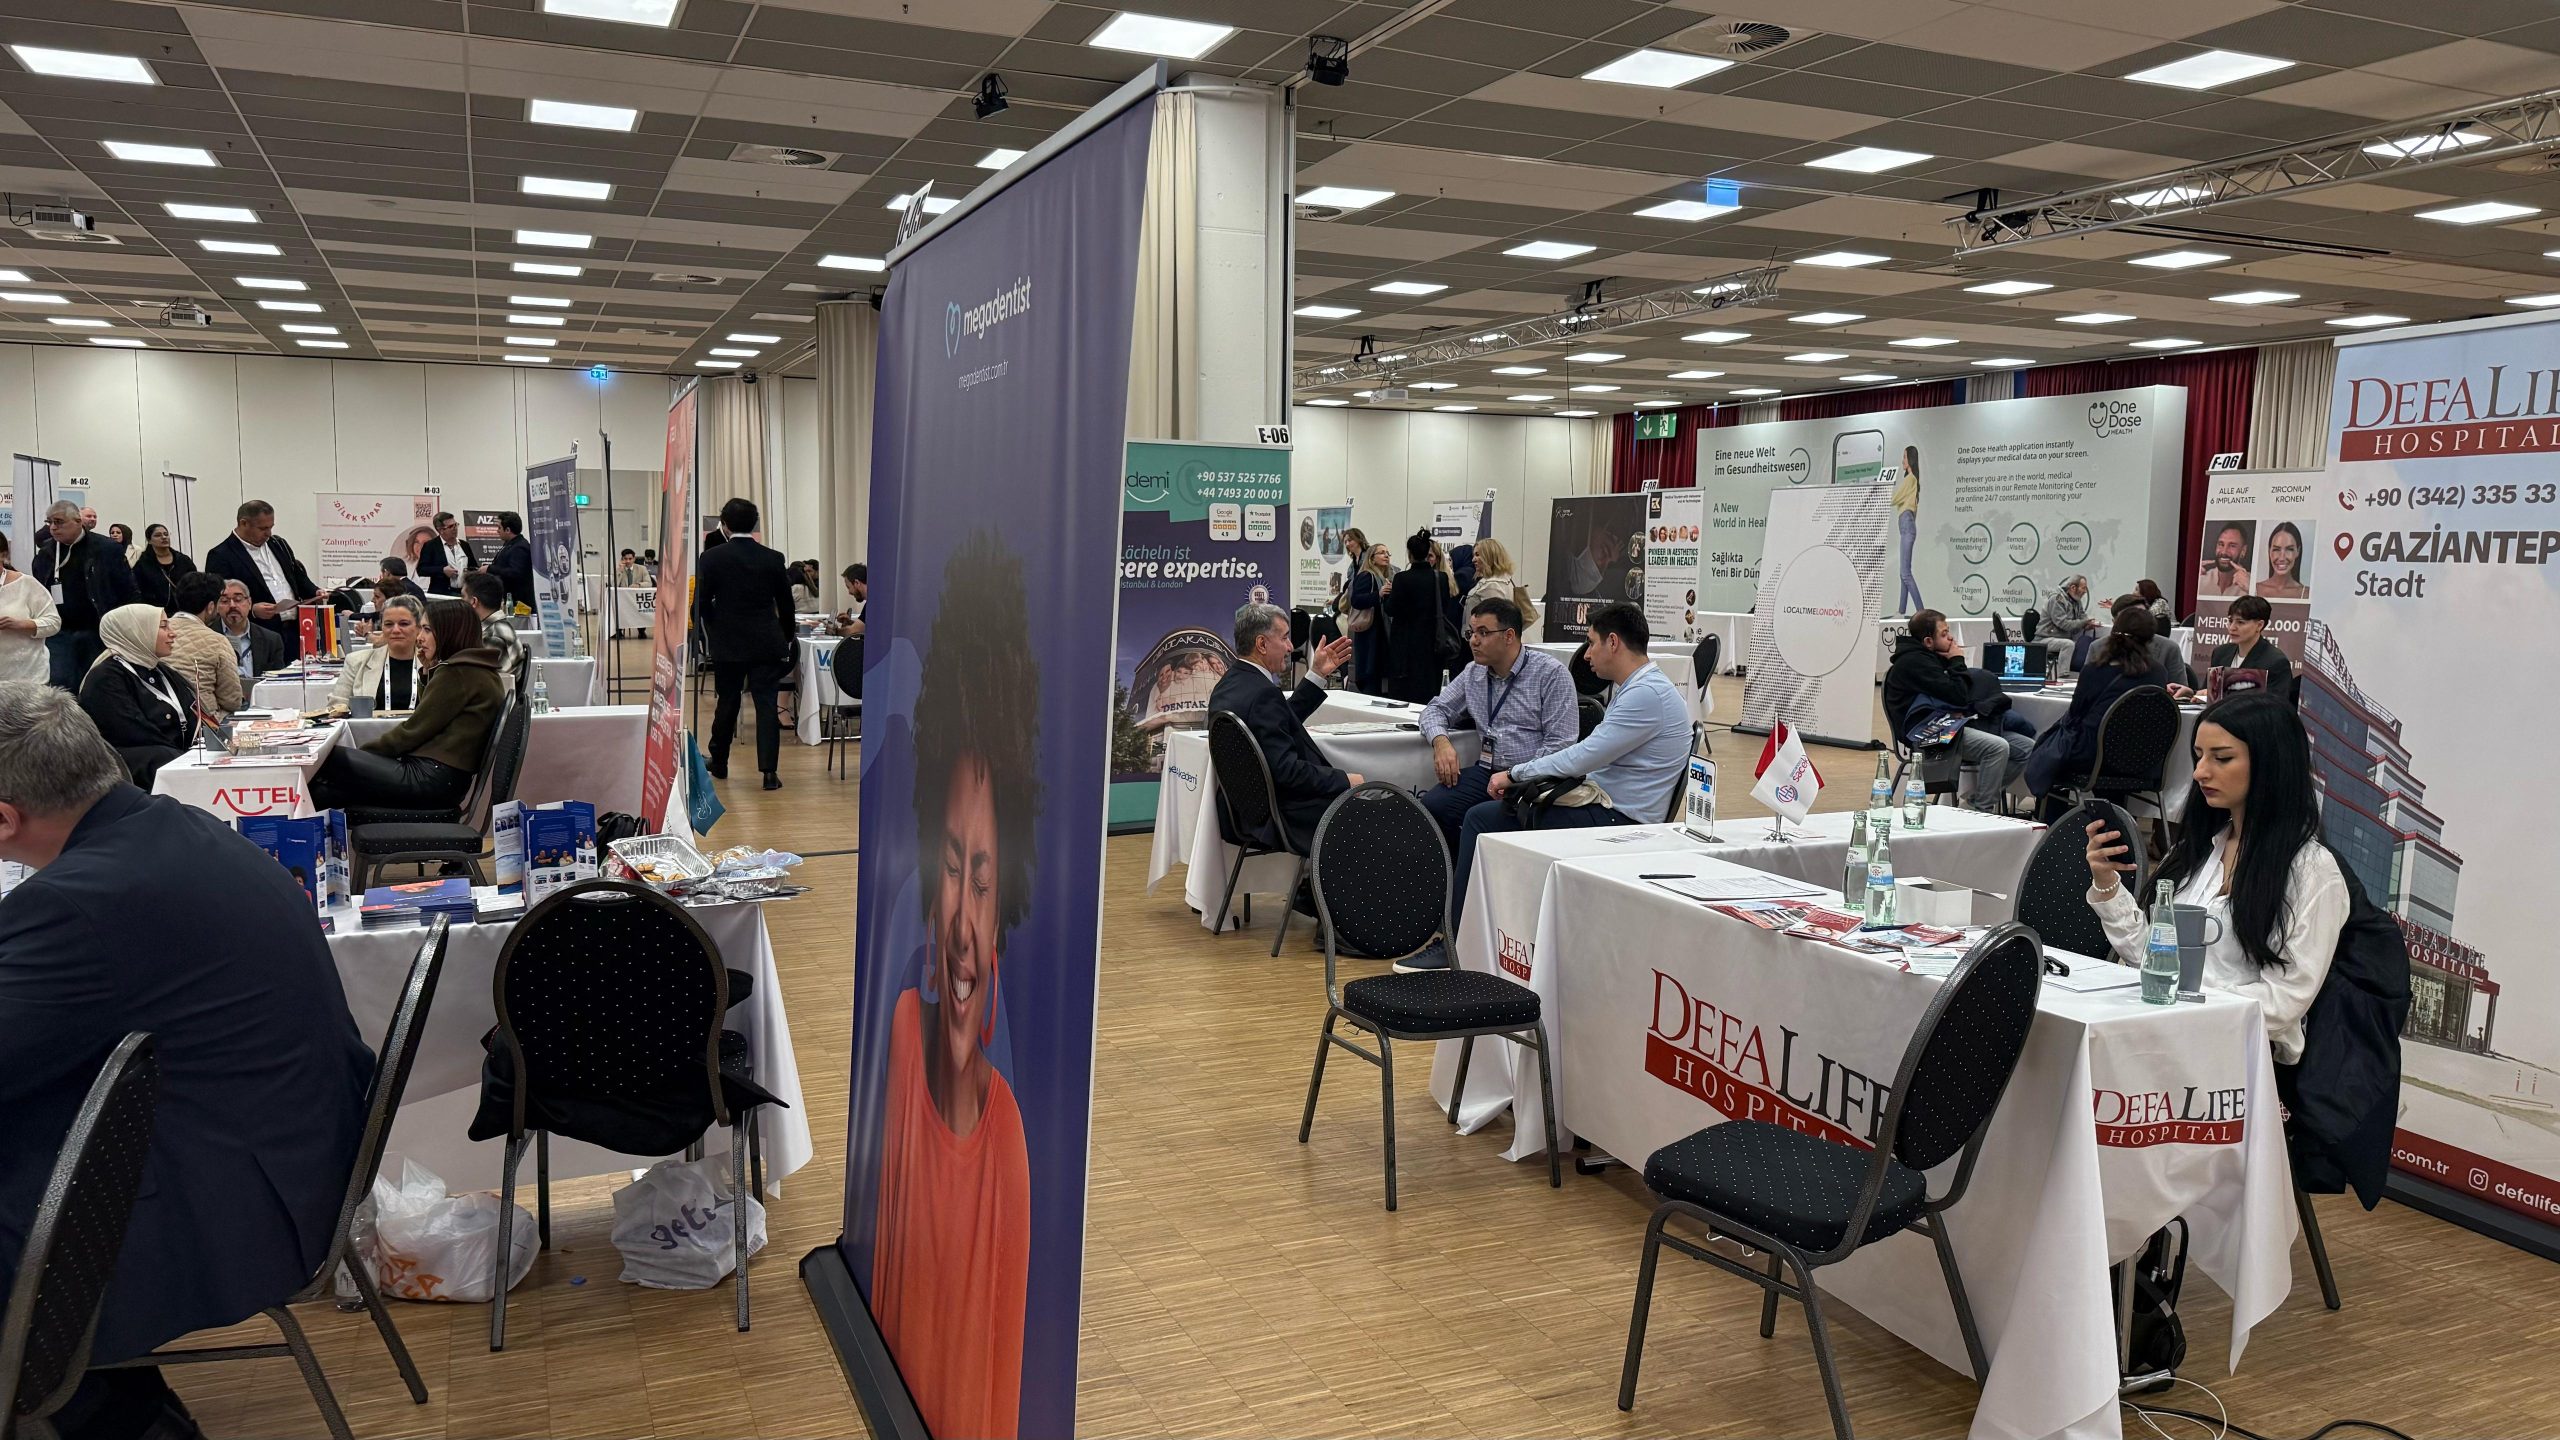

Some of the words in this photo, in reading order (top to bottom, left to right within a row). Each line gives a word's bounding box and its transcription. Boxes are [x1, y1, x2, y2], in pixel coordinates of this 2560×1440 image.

[963, 276, 1031, 339] megadentist
[958, 360, 1009, 391] megadentist.com.tr
[2109, 401, 2137, 414] One
[2109, 415, 2142, 428] Dose
[1259, 427, 1289, 444] E-06
[1987, 444, 2008, 452] Health
[2009, 442, 2044, 452] application
[2045, 439, 2074, 450] instantly
[1715, 450, 1732, 460] Eine
[1733, 450, 1754, 459] neue
[1756, 447, 1776, 457] Welt
[1957, 454, 1981, 464] displays
[1997, 453, 2021, 462] medical
[2023, 452, 2037, 460] data
[2065, 450, 2089, 458] screen.
[1714, 466, 1724, 475] im
[1727, 462, 1805, 475] Gesundheitswesen
[2211, 455, 2240, 470] F-06
[1197, 472, 1215, 482] +90
[1217, 472, 1236, 483] 537
[1237, 473, 1256, 483] 525
[1258, 473, 1281, 484] 7766
[1880, 469, 1896, 481] F-07
[1956, 476, 1983, 484] Wherever
[2026, 473, 2046, 481] world,
[2047, 471, 2072, 480] medical
[71, 478, 89, 486] M-02
[1955, 485, 1994, 495] professionals
[2014, 483, 2038, 491] Remote
[2038, 482, 2073, 491] Monitoring
[2075, 481, 2096, 489] Center
[1197, 488, 1215, 498] +44
[1218, 489, 1241, 499] 7493
[1243, 489, 1256, 499] 20
[1257, 490, 1270, 499] 00
[1271, 490, 1283, 500] 01
[2271, 485, 2311, 494] ZIRCONIUM
[1984, 494, 1997, 502] 24/7
[1999, 493, 2030, 502] constantly
[2031, 492, 2066, 501] monitoring
[2067, 492, 2082, 500] your
[2365, 488, 2402, 507] +90
[2408, 484, 2466, 509] (342)
[2472, 485, 2517, 505] 335
[2525, 484, 2557, 504] 33
[1713, 504, 1719, 513] A
[1721, 503, 1739, 512] New
[1954, 505, 1973, 513] health.
[1713, 518, 1736, 528] World
[1738, 518, 1746, 527] in
[1748, 518, 1766, 527] Heal
[2055, 536, 2081, 544] Symptom
[2360, 523, 2560, 565] GAZİANTEP
[1174, 545, 1190, 560] ist
[1955, 544, 1983, 552] Monitoring
[1648, 556, 1669, 566] LEADER
[1669, 557, 1676, 565] IN
[1676, 556, 1697, 566] HEALTH
[1711, 552, 1743, 565] Sağlıkta
[1163, 557, 1262, 582] expertise.
[1712, 568, 1729, 577] Yeni
[1730, 568, 1741, 577] Bir
[1744, 567, 1760, 578] Dün
[1150, 580, 1157, 588] &
[1157, 580, 1183, 588] London
[2355, 570, 2425, 598] Stadt
[1965, 587, 1982, 595] Urgent
[2012, 596, 2032, 604] Opinion
[1783, 605, 1844, 617] LOCALTIMELONDON
[2198, 616, 2229, 628] MEHR
[2006, 628, 2022, 637] One
[2405, 940, 2475, 980] OSPITAL
[1503, 957, 1527, 977] HOSP
[2092, 1086, 2245, 1124] DEFALIFE
[2108, 1125, 2231, 1145] HOSPITAL
